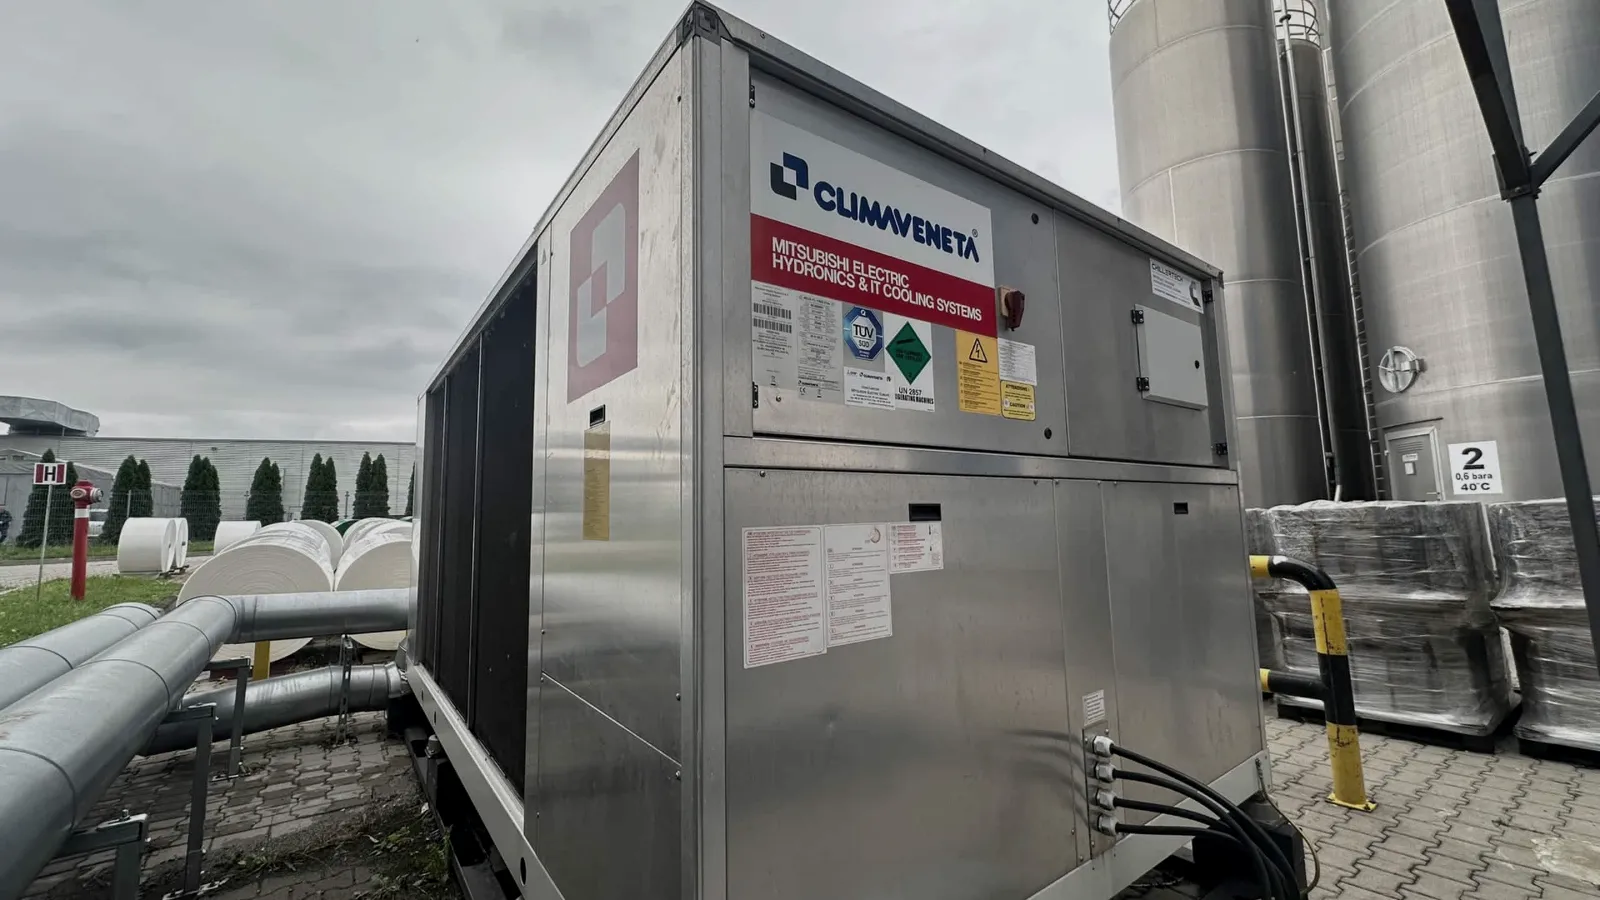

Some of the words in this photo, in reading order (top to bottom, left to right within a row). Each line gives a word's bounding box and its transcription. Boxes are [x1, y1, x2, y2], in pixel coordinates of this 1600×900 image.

[813, 180, 980, 263] CLIMAVENETA
[771, 236, 850, 272] MITSUBISHI
[852, 259, 910, 289] ELECTRIC
[771, 252, 857, 289] HYDRONICS
[858, 276, 868, 292] &
[869, 278, 881, 296] IT
[882, 281, 934, 309] COOLING
[936, 298, 982, 321] SYSTEMS
[898, 386, 908, 395] UN
[909, 388, 922, 396] 2857
[45, 466, 56, 482] H
[1461, 447, 1485, 470] 2
